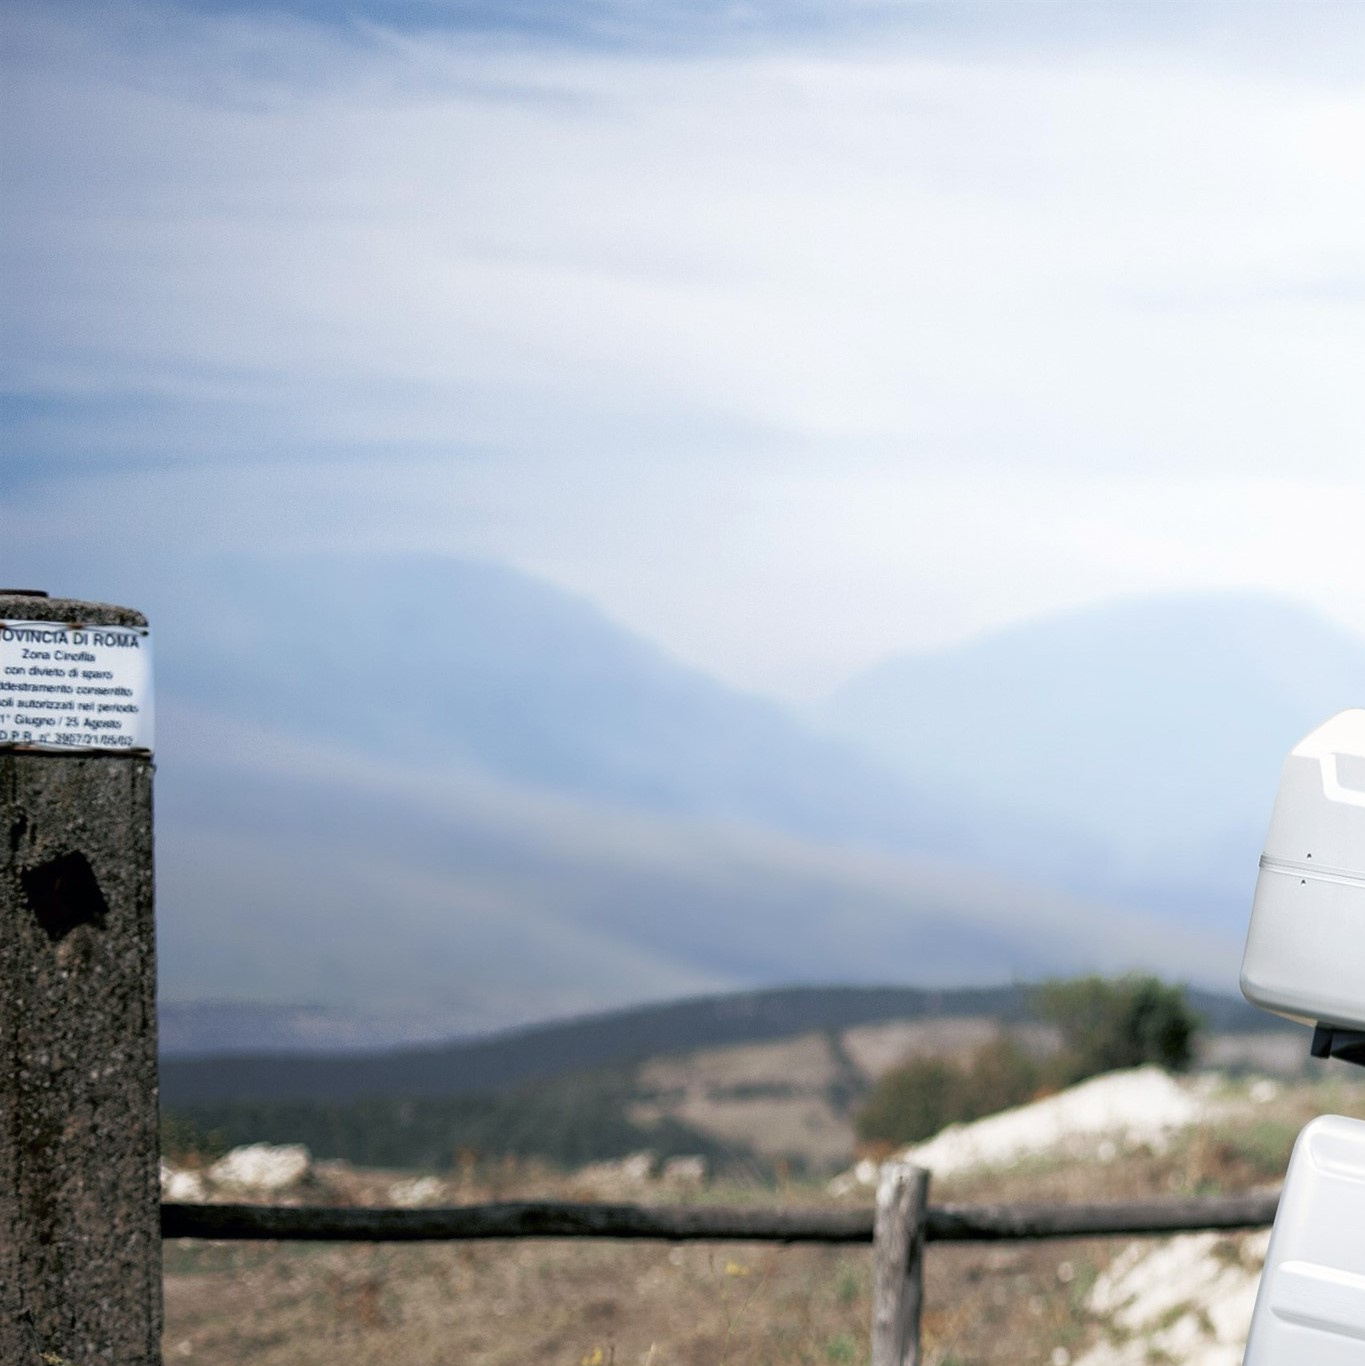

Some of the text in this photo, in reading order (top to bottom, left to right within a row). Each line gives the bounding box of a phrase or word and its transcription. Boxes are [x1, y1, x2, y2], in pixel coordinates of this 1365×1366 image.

[0, 629, 139, 648] OVINCIA DI ROMA
[22, 648, 50, 660] Zona
[5, 666, 113, 680] con divieto di sparo
[14, 714, 56, 727] Giugno
[83, 718, 122, 730] Agosto
